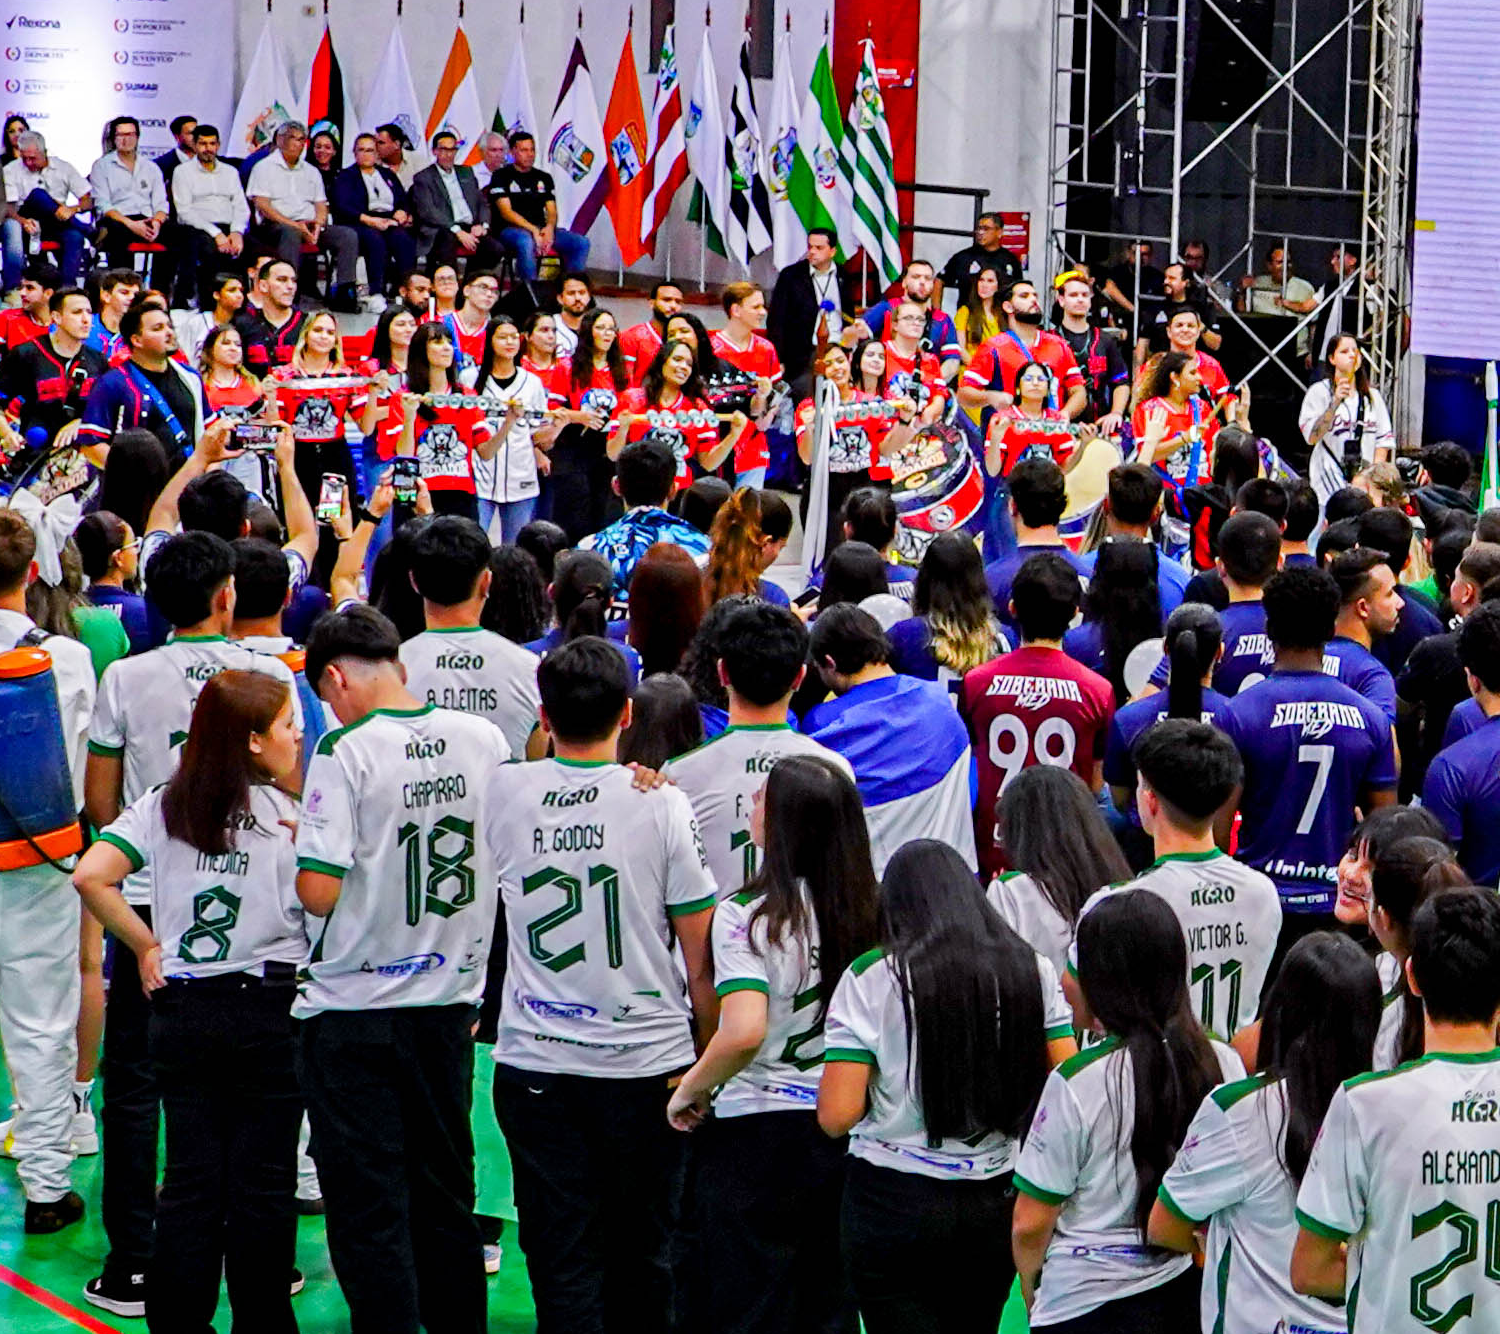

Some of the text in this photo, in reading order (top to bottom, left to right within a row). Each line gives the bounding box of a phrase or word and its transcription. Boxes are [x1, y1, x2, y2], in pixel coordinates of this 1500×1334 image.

[19, 16, 60, 28] Rexona
[125, 83, 158, 91] SUMAR
[436, 654, 484, 670] AGRO
[985, 675, 1083, 703] SOBERANA
[1015, 692, 1052, 711] MED
[1271, 702, 1366, 730] SOBERANA
[1301, 720, 1333, 739] MED
[405, 738, 446, 760] AGRO
[403, 774, 467, 809] CHAPIRRO
[542, 786, 599, 808] AGRO
[1296, 744, 1335, 835] 7
[533, 824, 604, 854] A. GODOY
[398, 814, 475, 927] 18
[1191, 887, 1235, 906] AGRO
[178, 884, 242, 964] 8
[522, 863, 622, 974] 21
[1189, 922, 1248, 952] VICTOR G.
